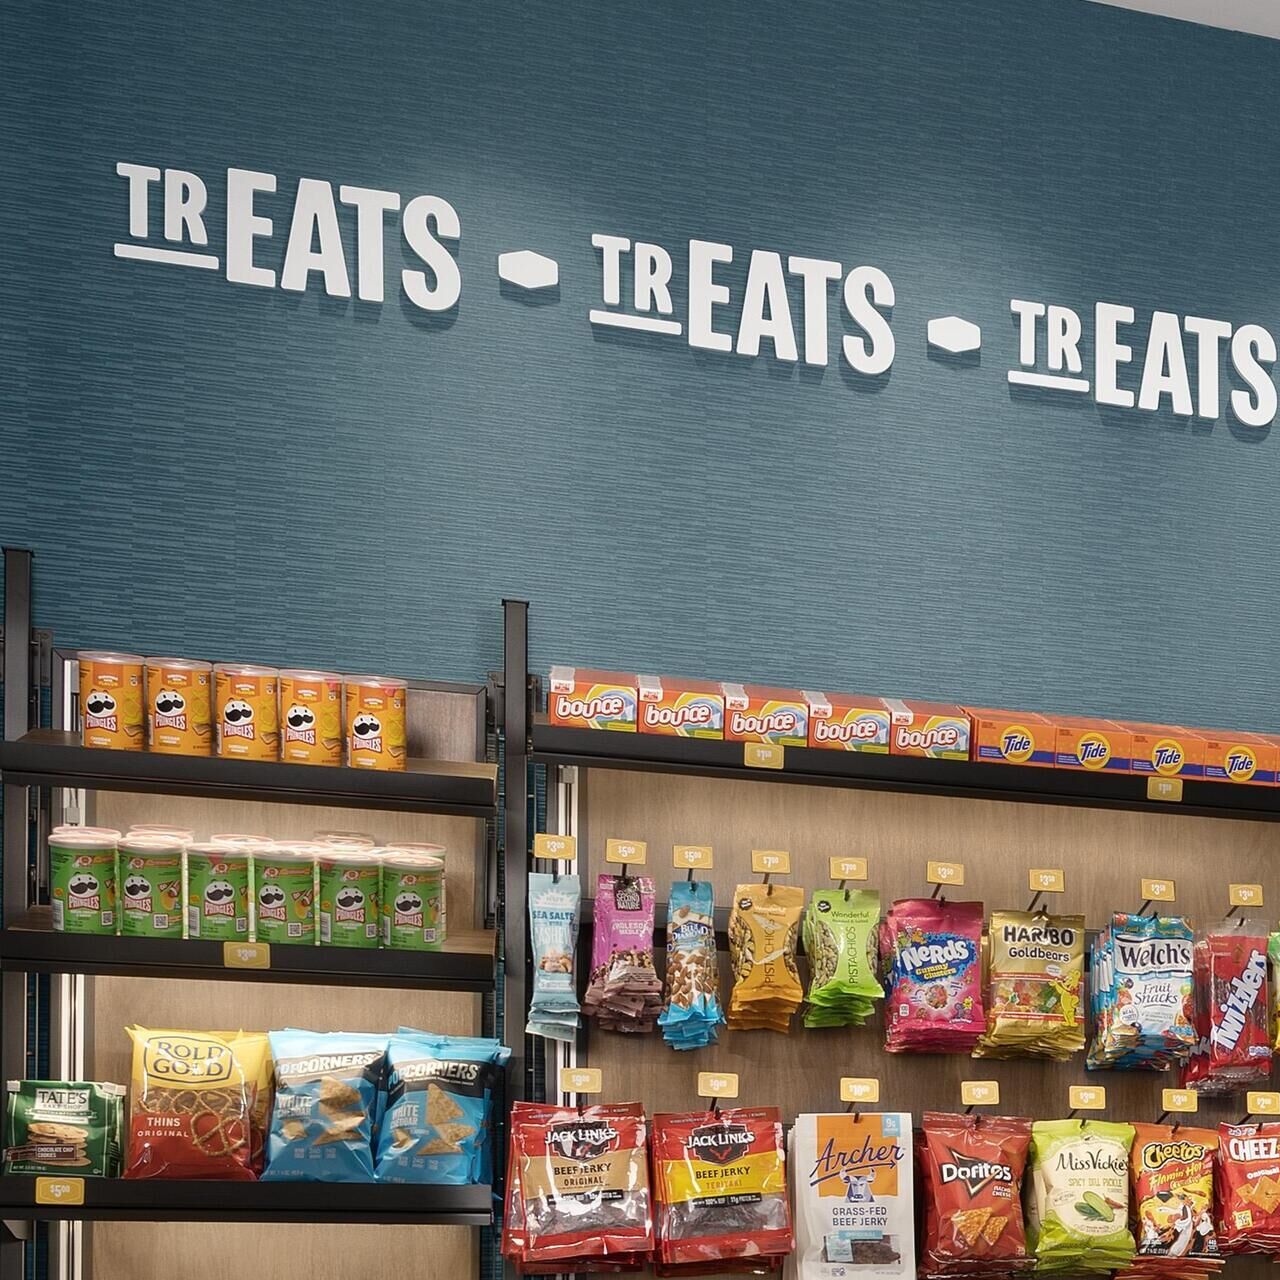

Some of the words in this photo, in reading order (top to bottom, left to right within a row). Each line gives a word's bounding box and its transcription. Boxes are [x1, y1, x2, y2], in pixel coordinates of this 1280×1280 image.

[114, 161, 461, 312] TREATS
[590, 233, 896, 375] TREATS
[1008, 300, 1277, 426] TREATS
[556, 696, 625, 719] bounce
[645, 704, 711, 727] bounce
[86, 714, 117, 732] PRINGLES
[154, 713, 186, 731] PRINGLES
[224, 722, 255, 739] PRINGLES
[732, 712, 796, 734] bounce
[1002, 734, 1031, 755] Tide
[1080, 742, 1107, 762] Tide
[1154, 749, 1182, 768] Tide
[1003, 926, 1074, 946] HARIBO
[848, 926, 859, 984] PISTACHIOS
[1009, 947, 1071, 962] Goldbears
[1119, 943, 1191, 968] Welch's
[1143, 983, 1172, 995] Fruit
[1134, 992, 1178, 1006] Snacks
[157, 1041, 224, 1060] ROLD
[154, 1059, 224, 1076] GOLD
[38, 1091, 87, 1104] TATE'S
[147, 1117, 181, 1127] THINS
[545, 1130, 576, 1144] JACK
[687, 1135, 717, 1148] JACK
[810, 1135, 904, 1178] Archer
[1056, 1153, 1090, 1171] Miss
[1144, 1142, 1204, 1165] Cheetos
[554, 1165, 578, 1176] BEEF
[695, 1170, 719, 1180] BEEF
[720, 1166, 751, 1178] JERKY
[941, 1164, 1012, 1183] Doritos
[564, 1176, 603, 1186] ORIGINAL
[1103, 1178, 1123, 1186] PICKLE
[832, 1218, 858, 1226] BEEF
[859, 1218, 888, 1226] JERKY
